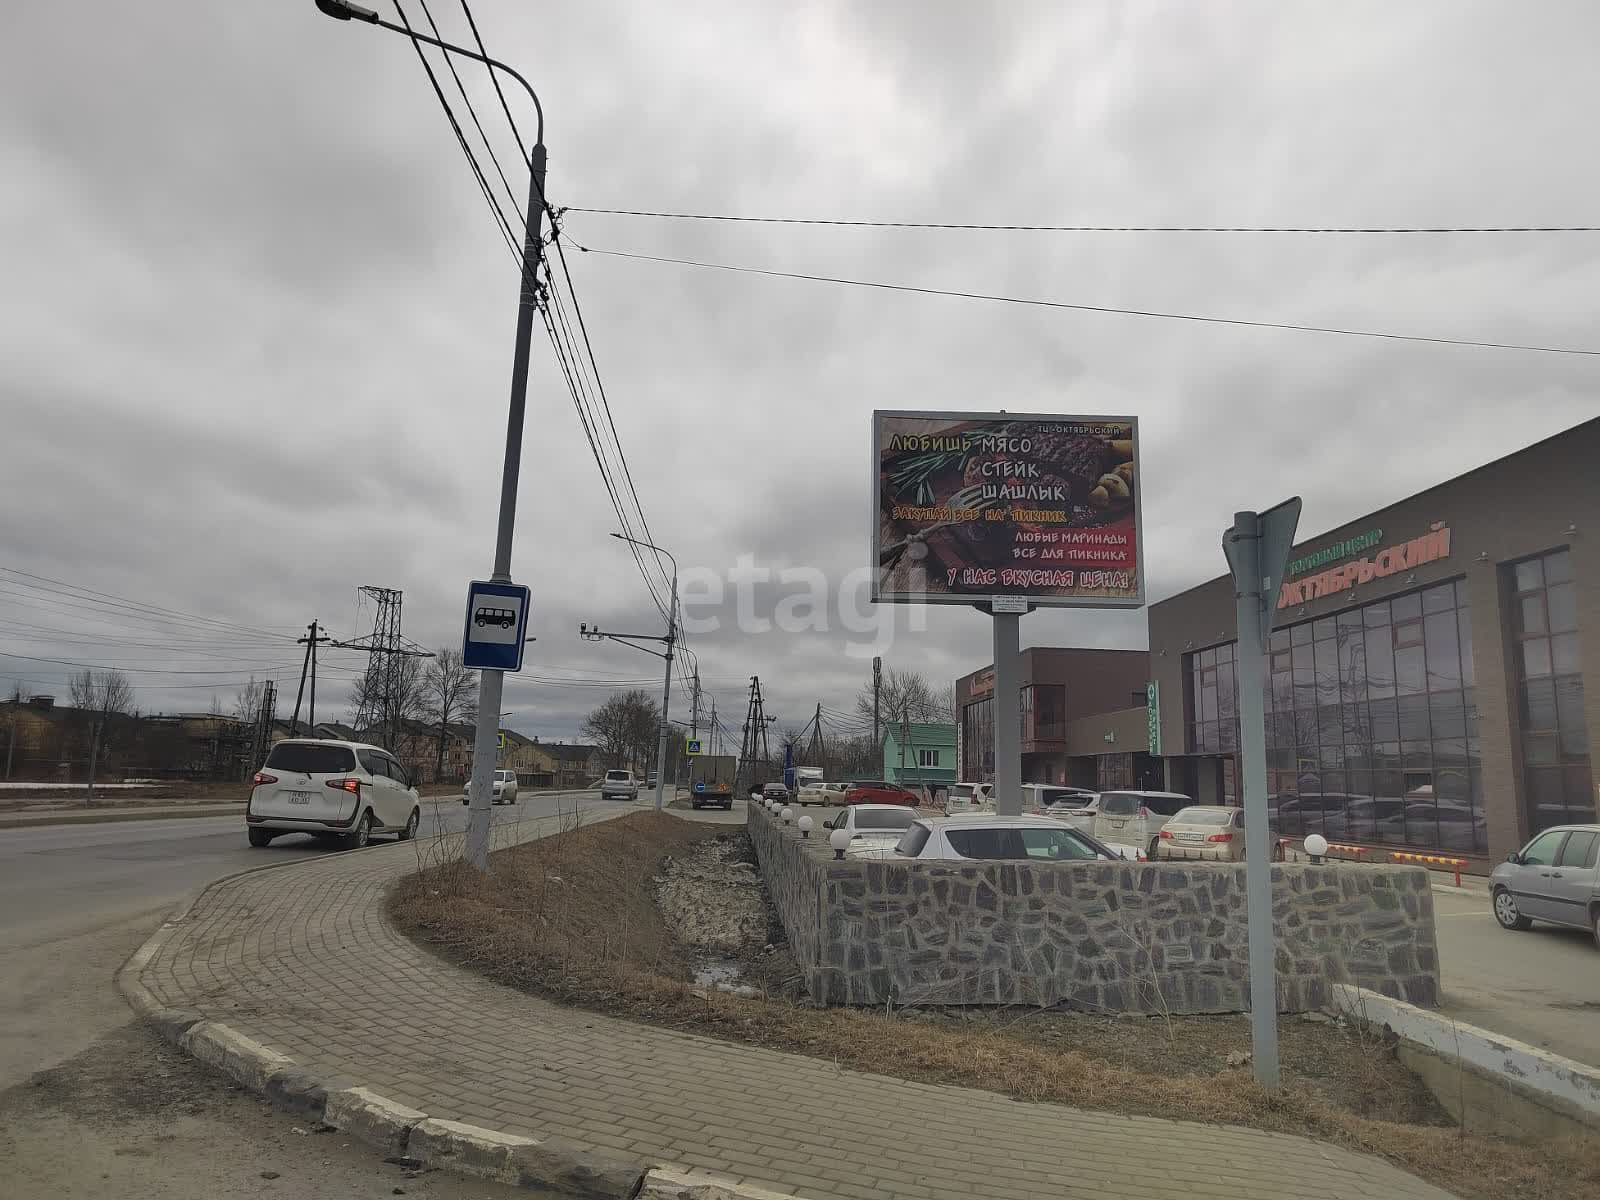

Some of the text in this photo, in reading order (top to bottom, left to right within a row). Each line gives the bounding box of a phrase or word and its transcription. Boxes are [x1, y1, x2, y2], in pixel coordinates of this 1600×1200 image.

[890, 434, 1032, 455] ЛЮБИШЬ МЯСО
[981, 460, 1039, 479] СТЕЙК
[981, 484, 1066, 501] ШАШЛЫК
[892, 506, 952, 521] ЗАКУПАЙ
[985, 509, 1003, 521] НА
[1010, 509, 1068, 523] ПИКНИК
[1015, 531, 1127, 545] ЛЮБЫЕ МАРИНАДЫ
[1012, 547, 1128, 562] ВСЕ ДЛЯ ПИКНИКА
[946, 568, 1129, 589] У НАС ВКУСНАЯ ЦЕНА!
